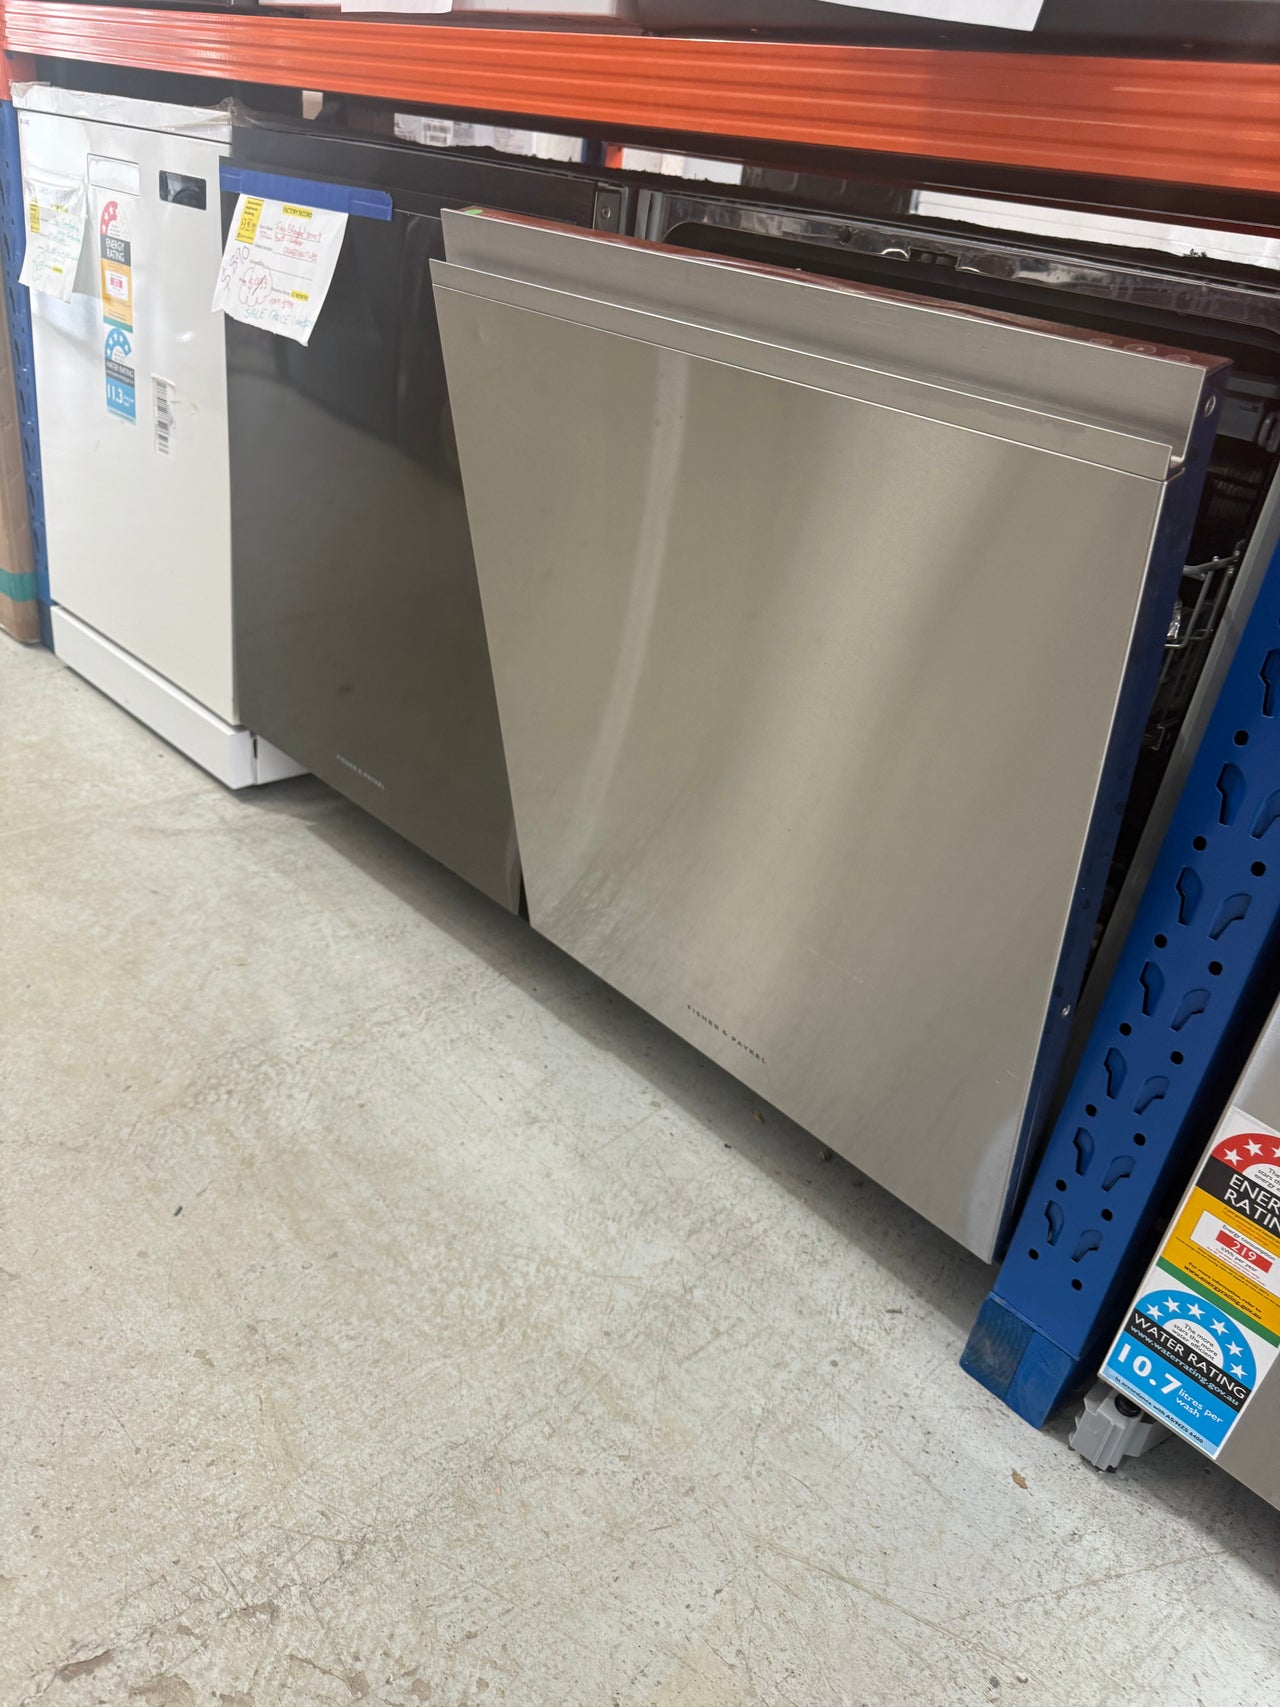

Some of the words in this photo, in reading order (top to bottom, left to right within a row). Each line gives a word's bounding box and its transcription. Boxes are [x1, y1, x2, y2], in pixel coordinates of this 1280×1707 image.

[106, 237, 125, 250] ENERGY
[106, 248, 125, 262] RATING
[1229, 1174, 1280, 1216] ENER
[1254, 1174, 1276, 1189] energy
[1222, 1224, 1240, 1239] Energy
[1241, 1237, 1276, 1261] consumption
[1230, 1240, 1257, 1261] 219
[1220, 1246, 1235, 1258] kWh
[1234, 1256, 1246, 1265] per
[1246, 1263, 1258, 1272] year
[1172, 1328, 1190, 1344] water
[1190, 1341, 1216, 1361] efficient
[1174, 1324, 1189, 1337] stars
[1189, 1334, 1200, 1344] the
[1200, 1342, 1218, 1356] more
[1184, 1323, 1196, 1334] The
[1196, 1333, 1214, 1348] more
[1118, 1342, 1182, 1394] 10.7
[1130, 1325, 1240, 1406] www.waterrating.gov.au
[1135, 1312, 1184, 1357] WATER
[1187, 1353, 1248, 1400] RATING
[1152, 1404, 1166, 1416] with
[1176, 1397, 1200, 1418] wash
[1178, 1388, 1204, 1410] litres
[1204, 1409, 1224, 1425] per
